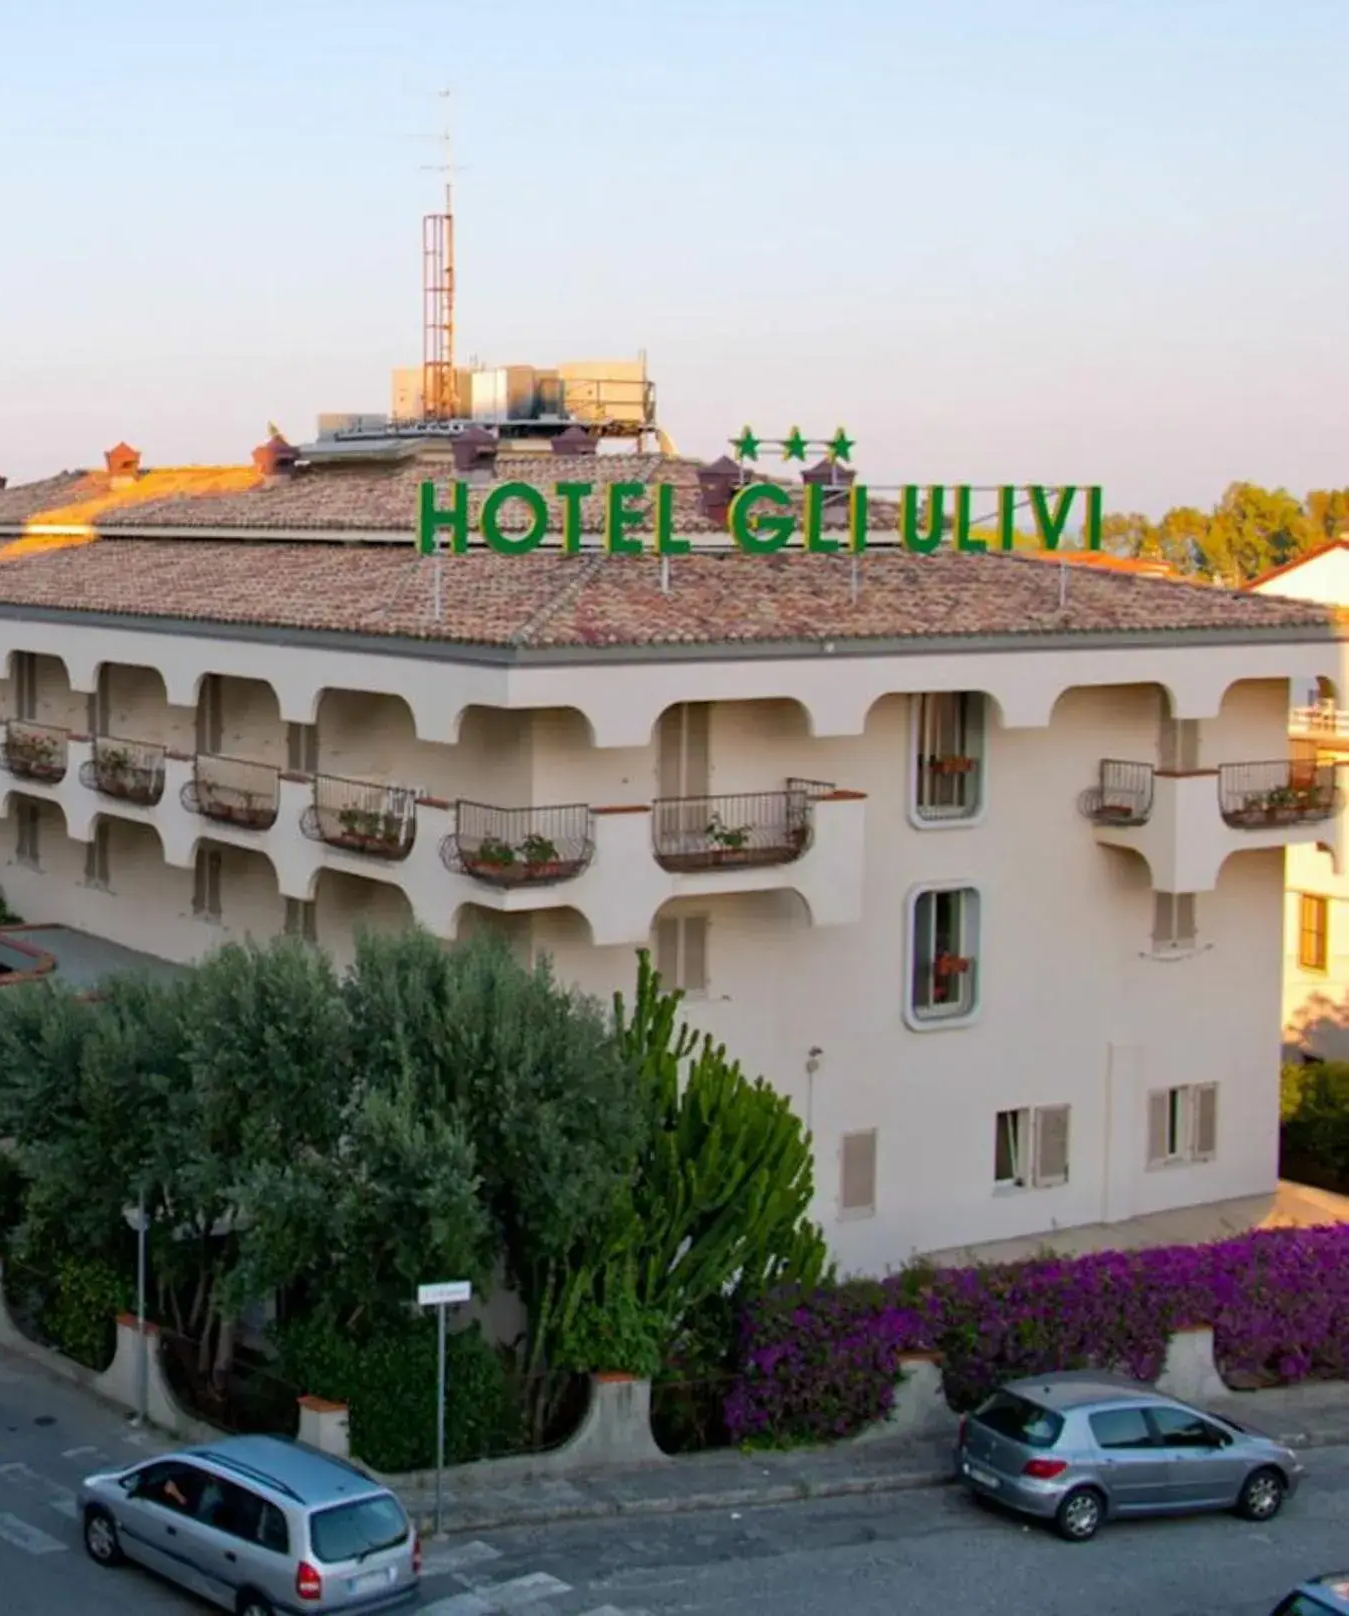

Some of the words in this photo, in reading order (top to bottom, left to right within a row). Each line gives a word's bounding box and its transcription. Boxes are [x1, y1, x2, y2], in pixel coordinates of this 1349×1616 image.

[416, 481, 690, 556] HOTEL
[729, 482, 868, 555] GLI
[901, 484, 1104, 554] ULIVI
